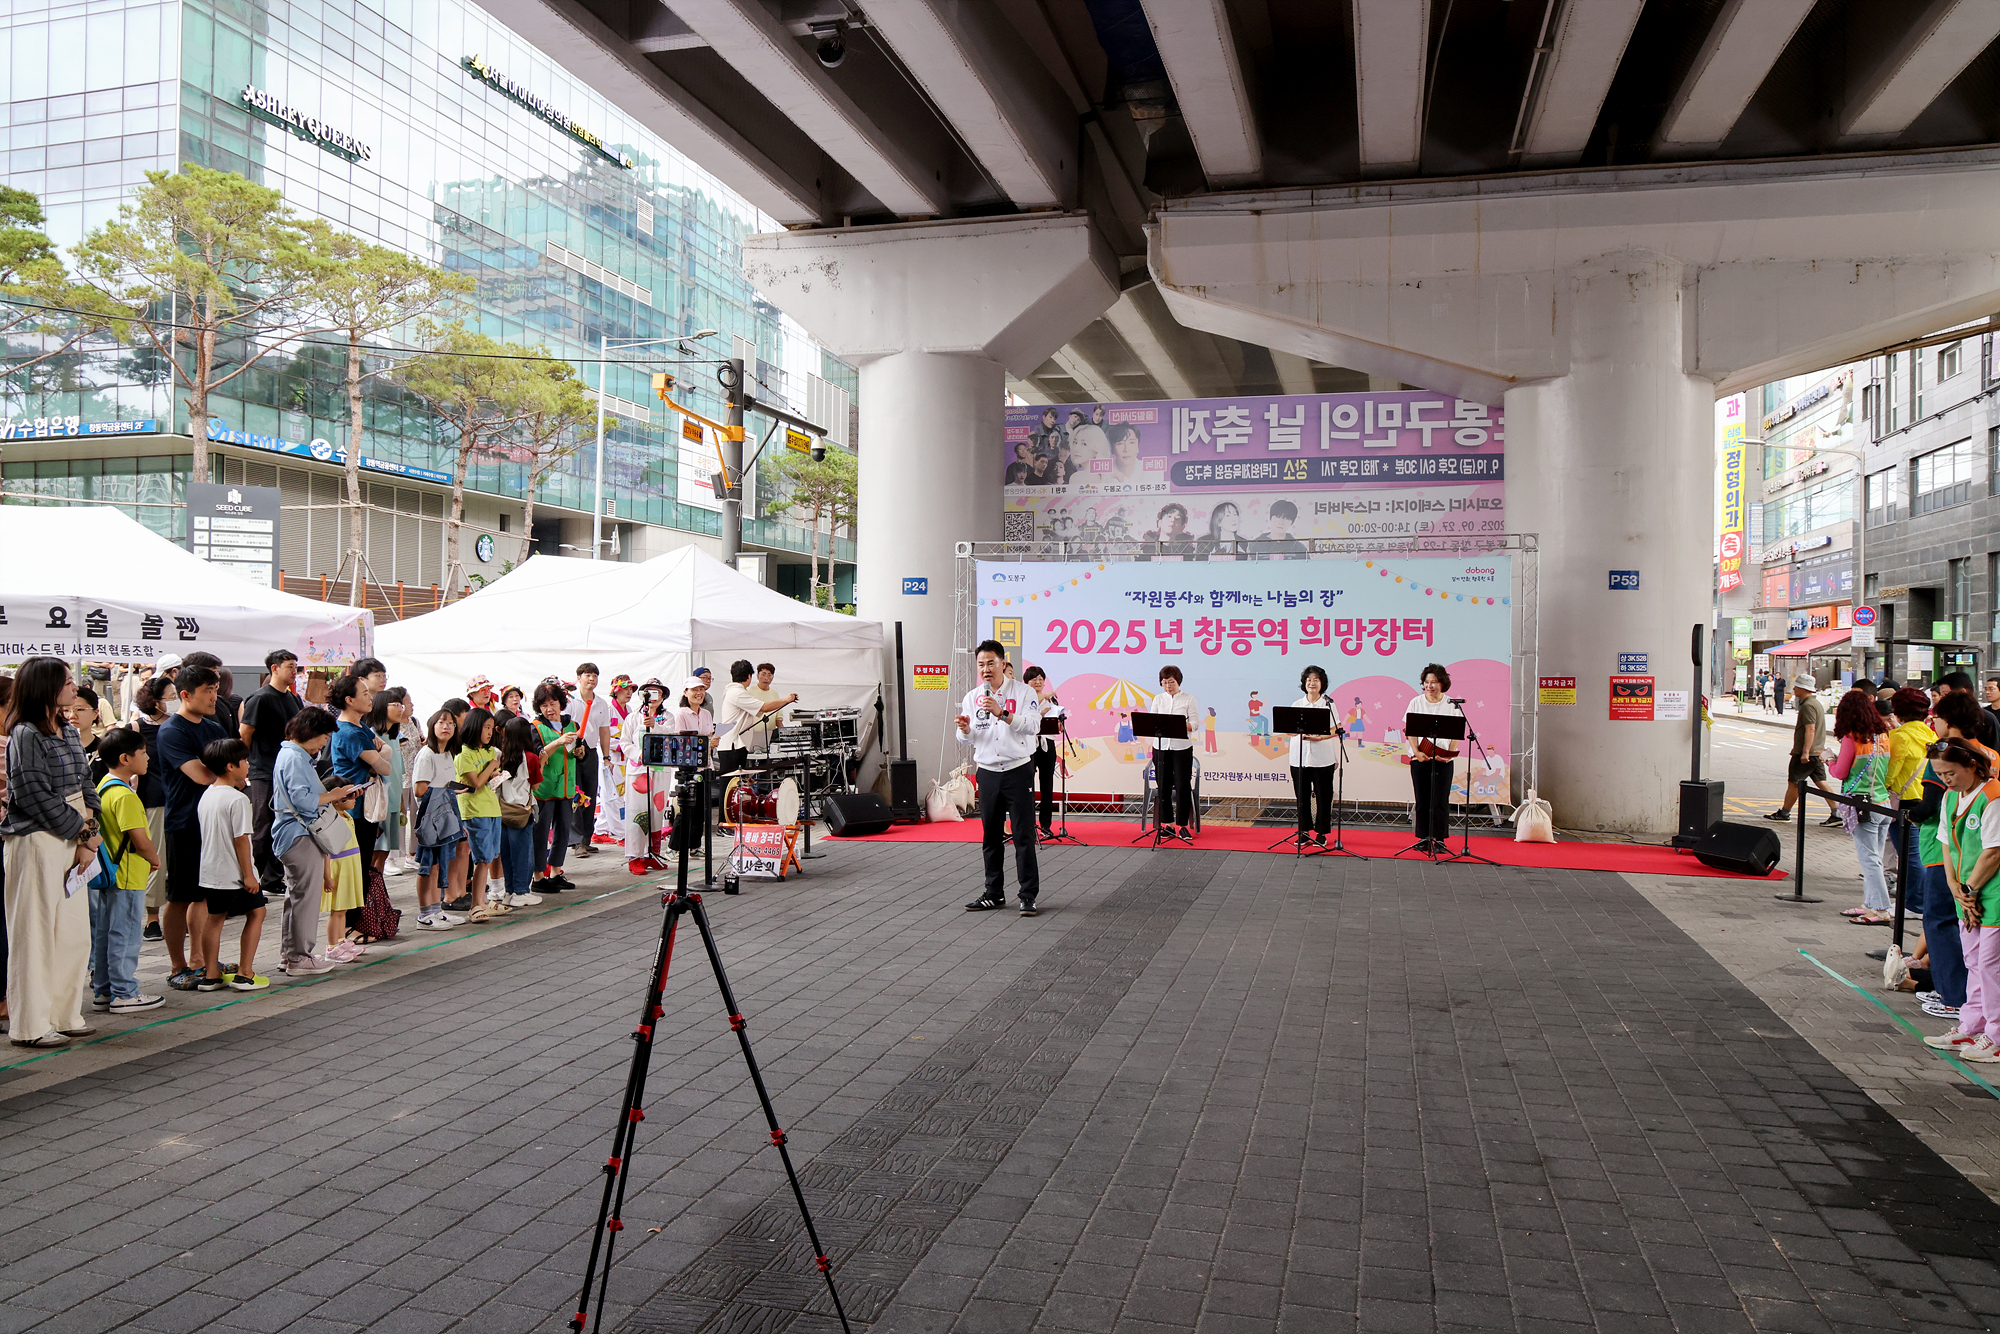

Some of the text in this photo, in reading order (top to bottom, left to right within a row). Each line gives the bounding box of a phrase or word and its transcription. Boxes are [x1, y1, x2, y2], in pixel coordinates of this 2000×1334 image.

[241, 84, 372, 161] ASHLEY QUEENS
[18, 416, 80, 436] 수협은행
[88, 422, 133, 433] 창동역금융센터
[134, 421, 144, 430] 2F
[234, 431, 286, 451] SUHYUP
[366, 458, 398, 472] 창동역금융센터
[216, 504, 253, 513] SEED CUBE
[1465, 566, 1495, 575] dobong
[1008, 574, 1026, 582] 도봉구
[1610, 574, 1638, 587] P53
[1718, 572, 1741, 590] 개원
[904, 582, 926, 591] P24
[1124, 590, 1344, 608] “자원봉사와 함께하는 나눔의 장”
[1194, 616, 1289, 656] 창동역
[1299, 616, 1435, 656] 희망장터
[0, 642, 154, 658] 마마스드림 사회적협동조합
[1620, 654, 1627, 662] 상
[1204, 772, 1252, 782] 민간자원봉사
[1254, 772, 1290, 783] 네트워크,
[760, 832, 782, 844] 창극단
